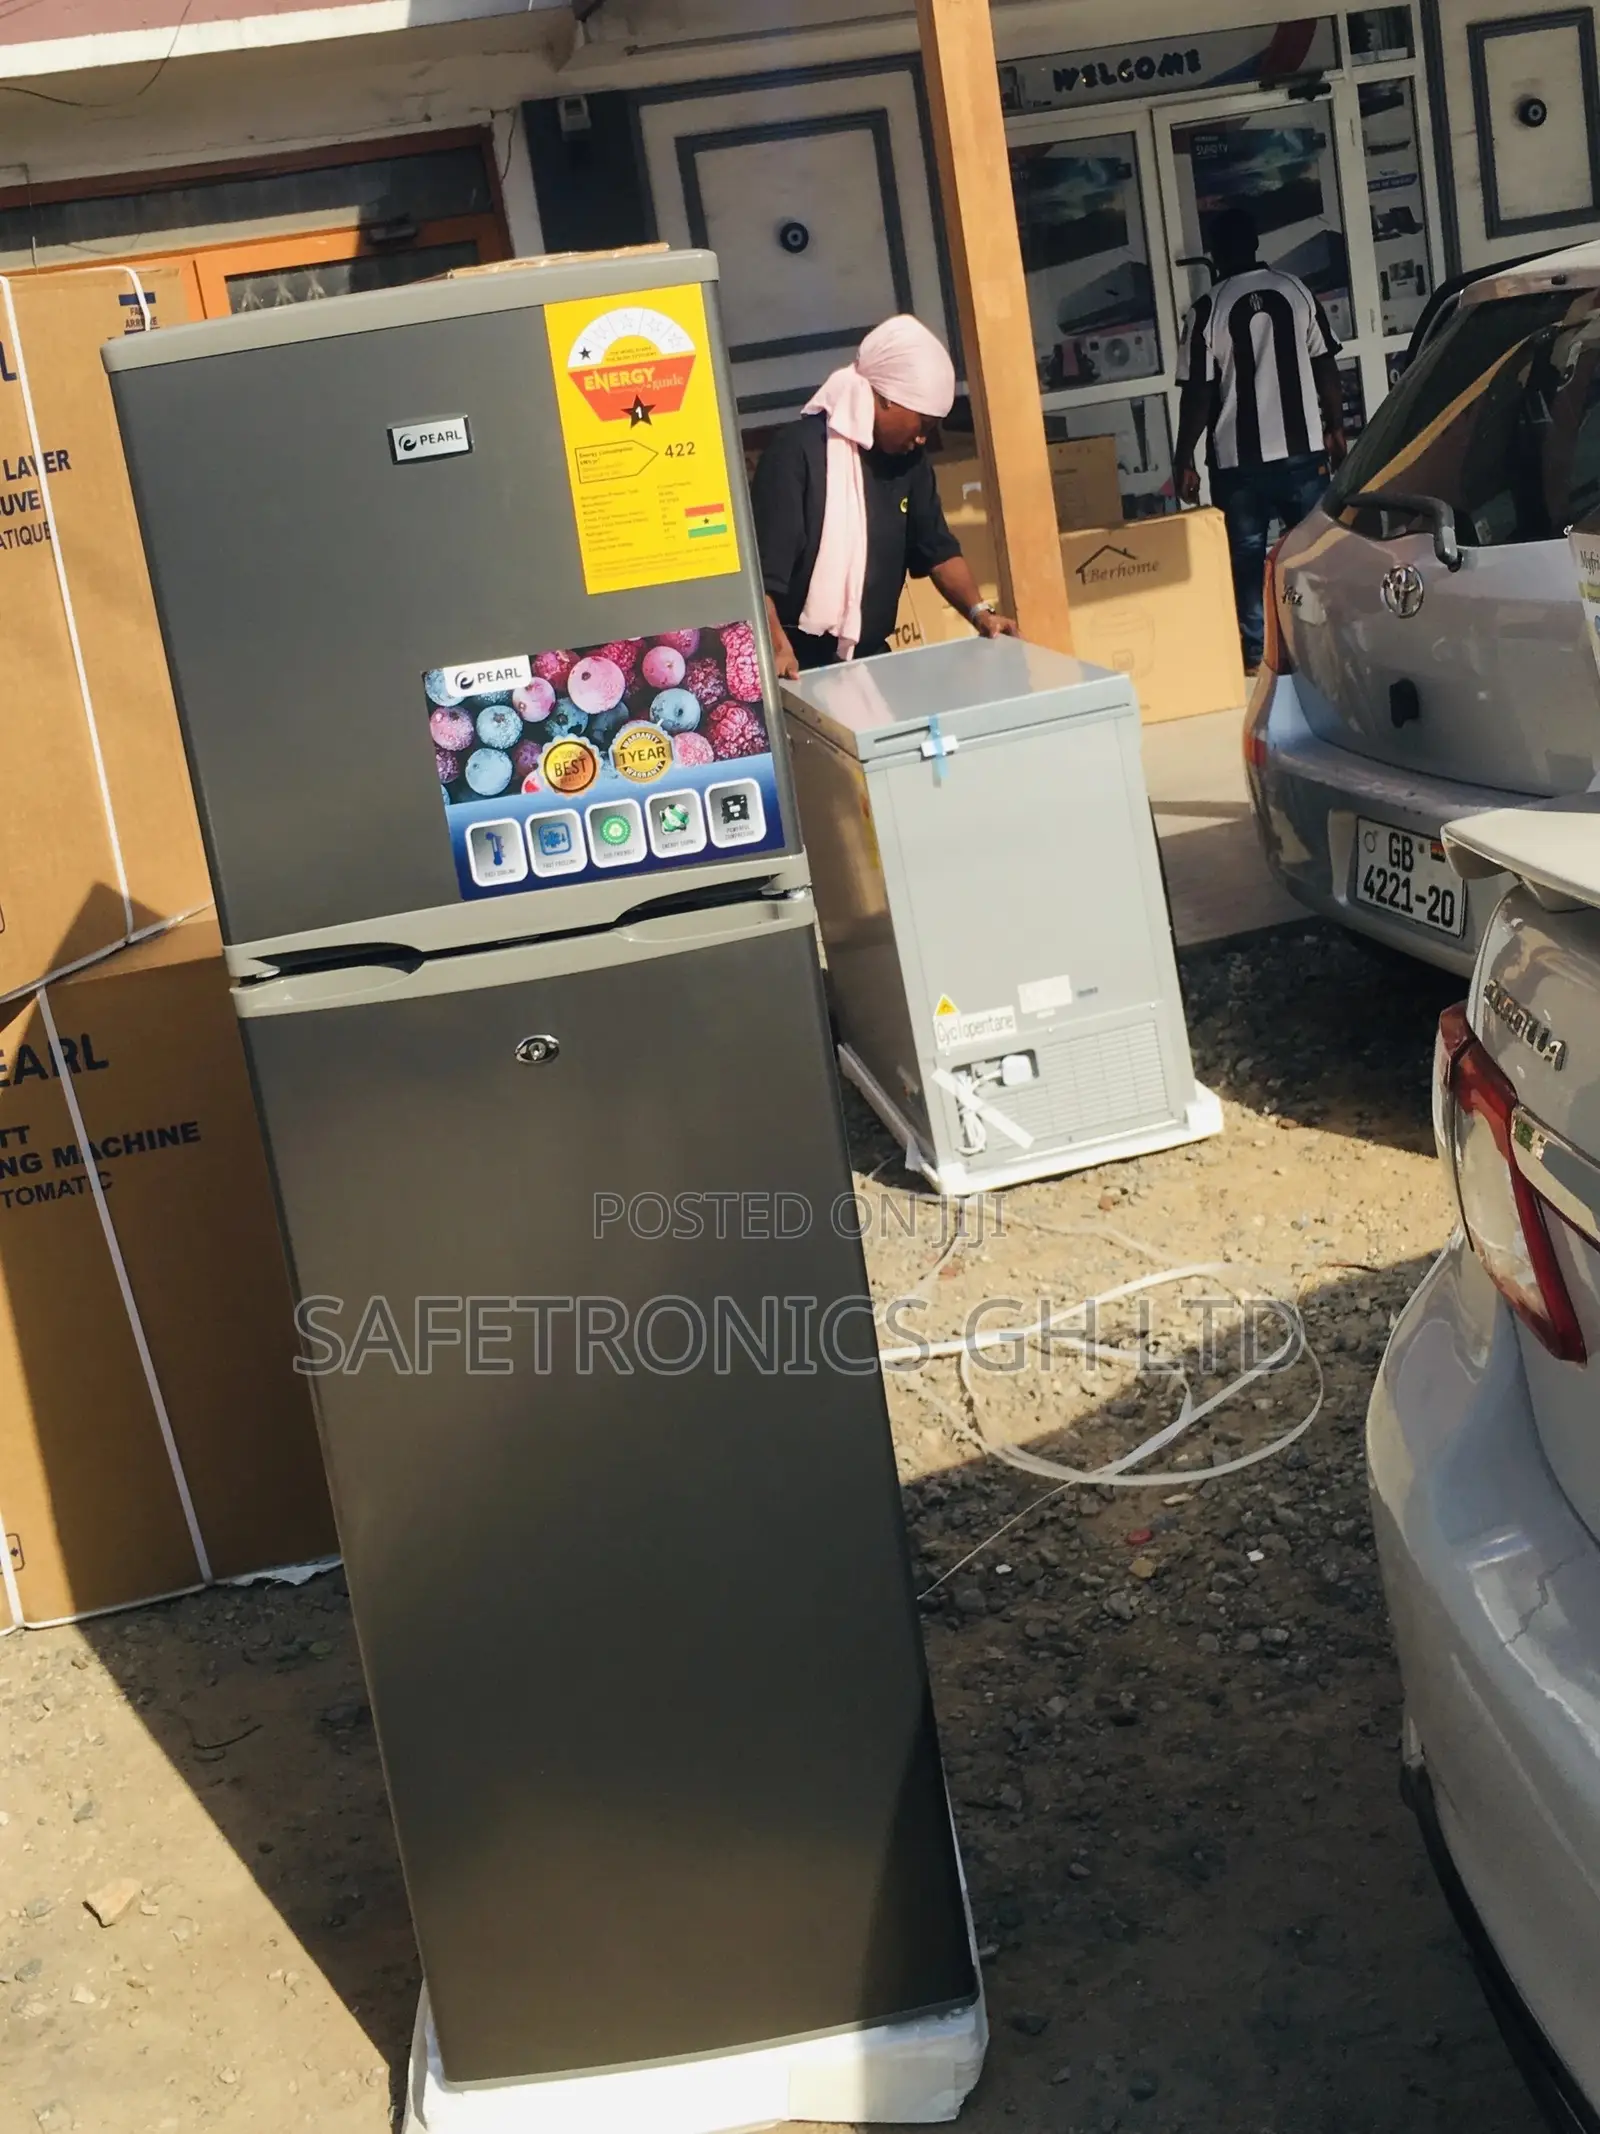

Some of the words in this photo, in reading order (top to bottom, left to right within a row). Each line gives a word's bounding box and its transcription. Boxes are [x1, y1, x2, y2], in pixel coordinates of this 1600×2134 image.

[1053, 48, 1202, 93] WELCOME
[583, 366, 655, 395] ENERGY
[635, 406, 643, 419] 1
[420, 430, 463, 446] PEARL
[664, 441, 696, 459] 422
[0, 490, 42, 517] UVE
[1090, 560, 1160, 581] Berhome
[894, 622, 922, 648] TCL
[477, 667, 523, 685] PEARL
[623, 732, 661, 749] WARRANTY
[619, 753, 627, 765] 1
[628, 745, 667, 763] YEAR
[553, 758, 588, 777] BEST
[625, 761, 664, 779] WARRANTY
[1388, 831, 1414, 873] GB
[1363, 864, 1455, 928] 4221-20
[936, 1014, 1015, 1045] Cyclopentane
[53, 1121, 201, 1168] MACHINE
[0, 1171, 113, 1209] TOMATC
